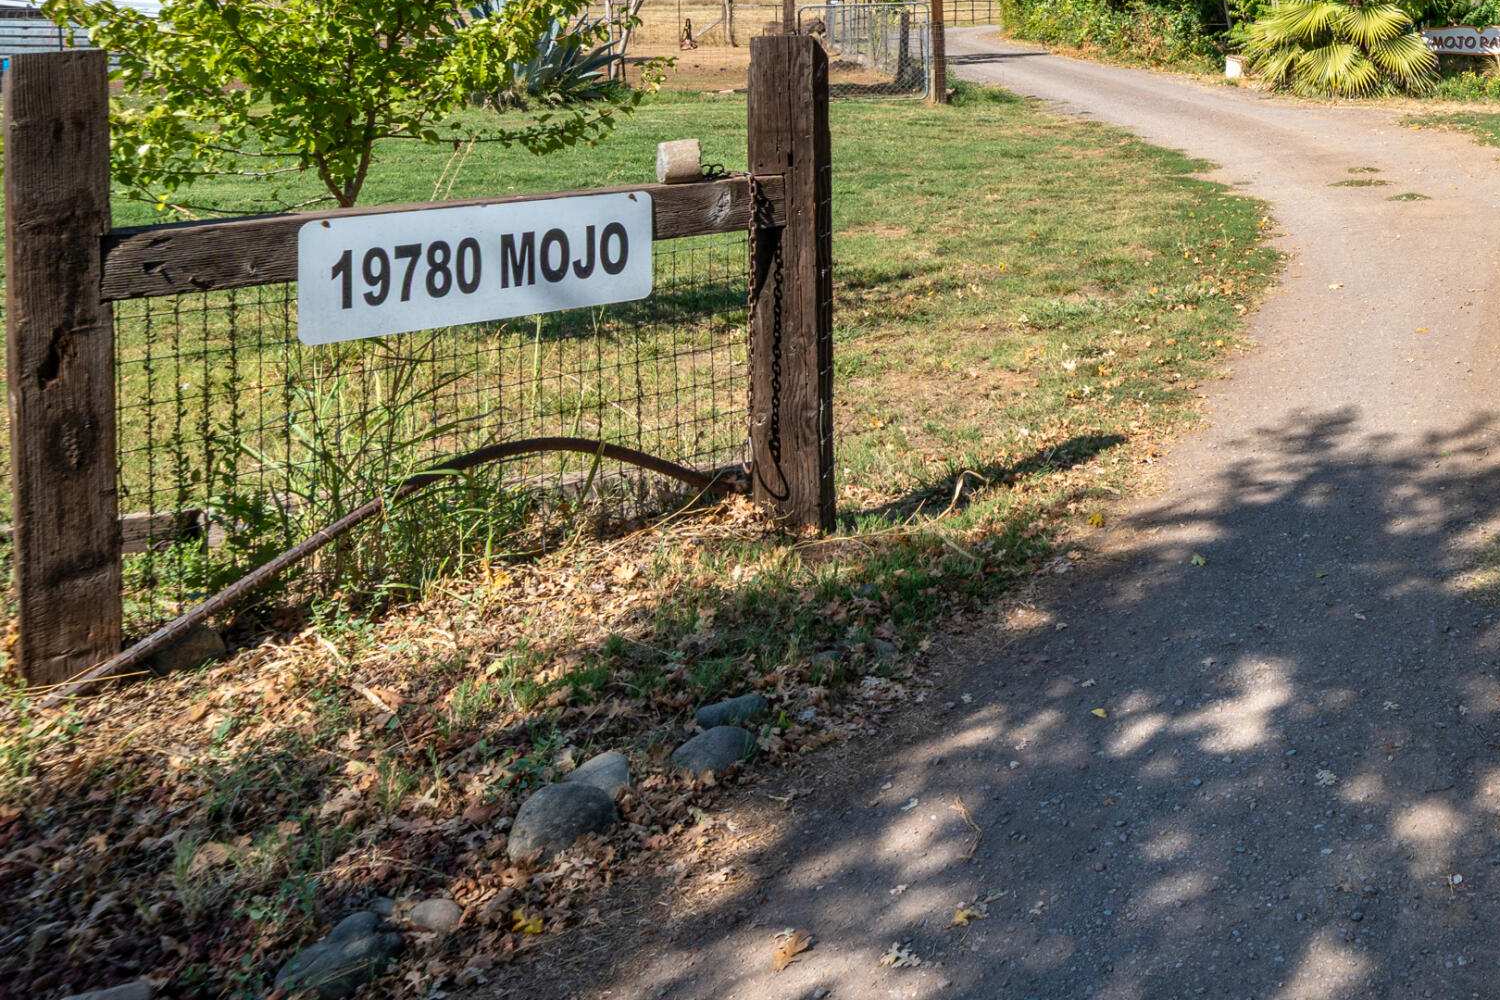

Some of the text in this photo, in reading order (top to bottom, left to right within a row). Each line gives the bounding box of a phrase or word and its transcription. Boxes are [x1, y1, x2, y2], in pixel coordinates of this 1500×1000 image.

[1432, 35, 1476, 49] MOJO
[331, 221, 629, 310] 19780 MOJO
